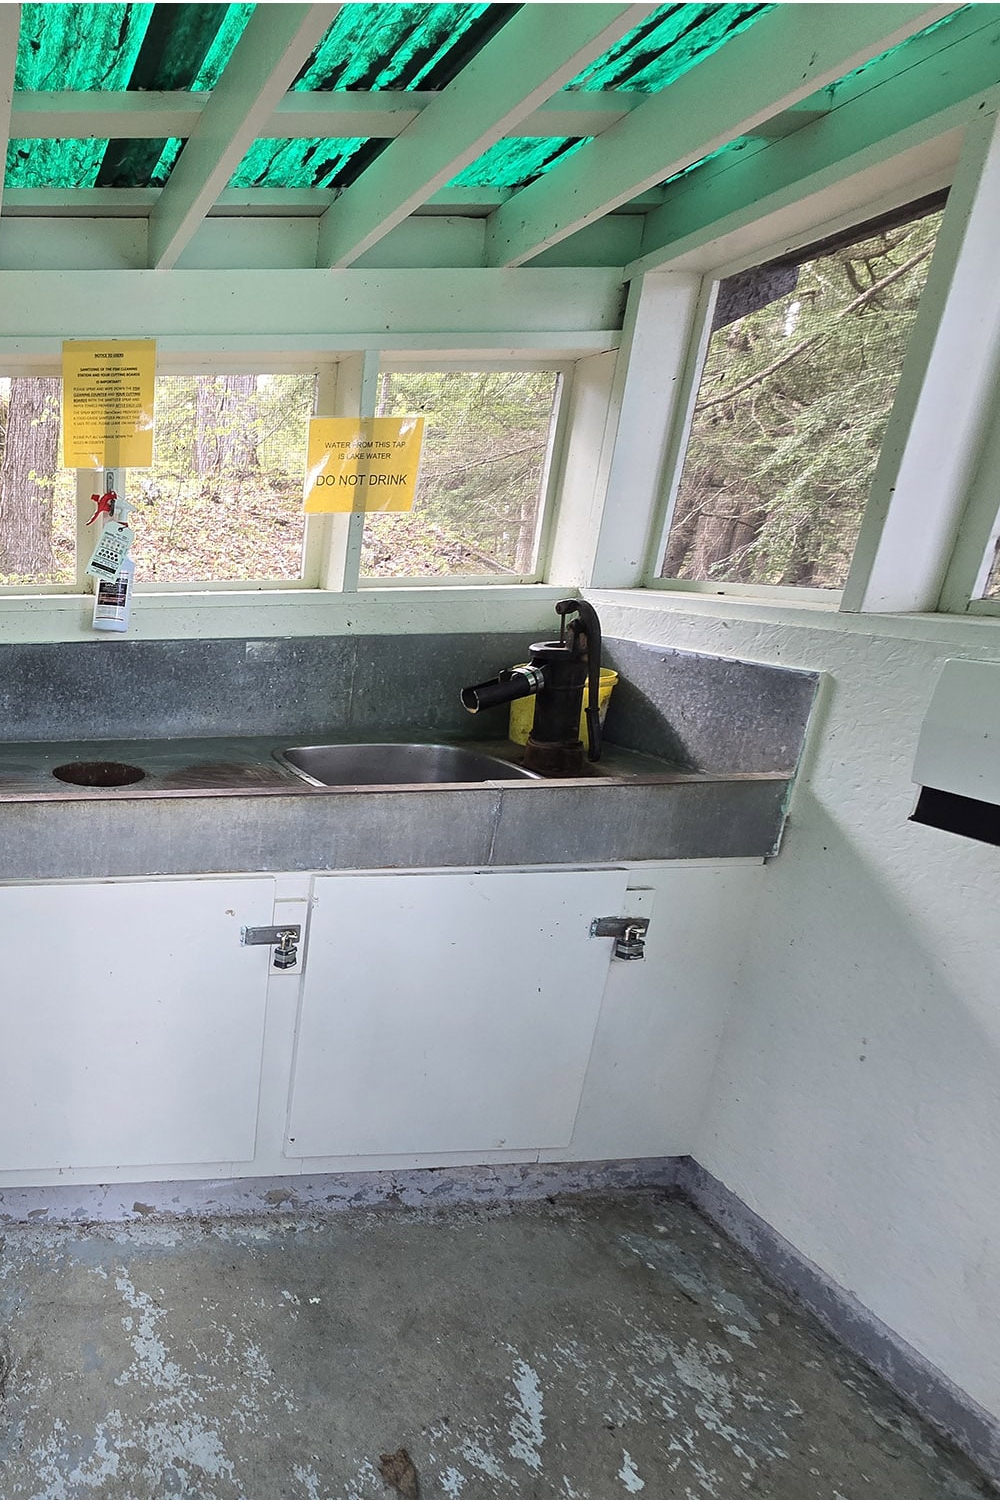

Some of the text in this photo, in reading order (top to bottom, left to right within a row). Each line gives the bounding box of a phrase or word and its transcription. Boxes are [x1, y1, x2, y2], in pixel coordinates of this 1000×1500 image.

[325, 441, 350, 449] WATER
[375, 441, 391, 449] THIS
[393, 441, 407, 449] TAP
[338, 452, 392, 460] IS LAKE WATER
[316, 474, 408, 487] DO NOT DRINK
